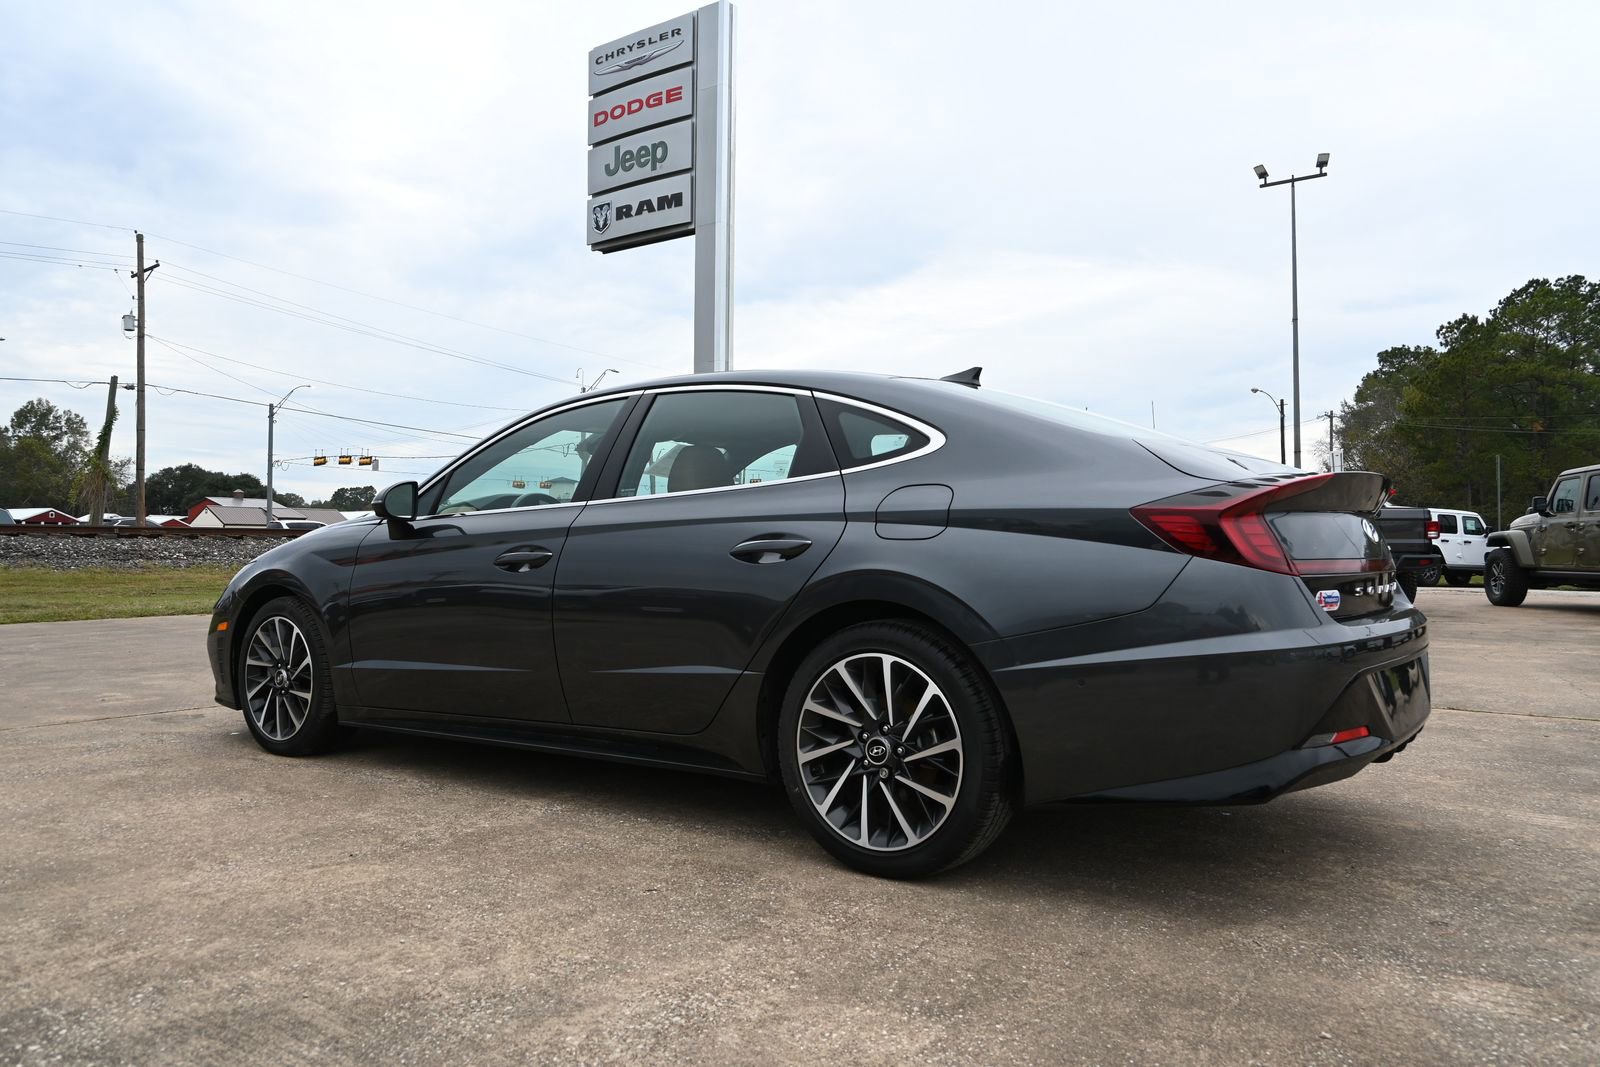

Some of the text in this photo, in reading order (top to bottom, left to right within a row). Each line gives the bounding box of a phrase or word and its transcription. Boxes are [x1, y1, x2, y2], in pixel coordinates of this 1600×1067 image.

[595, 28, 682, 65] CHRYSLER
[593, 86, 682, 127] DODGE
[604, 140, 668, 177] Jeep
[615, 192, 683, 221] RAM
